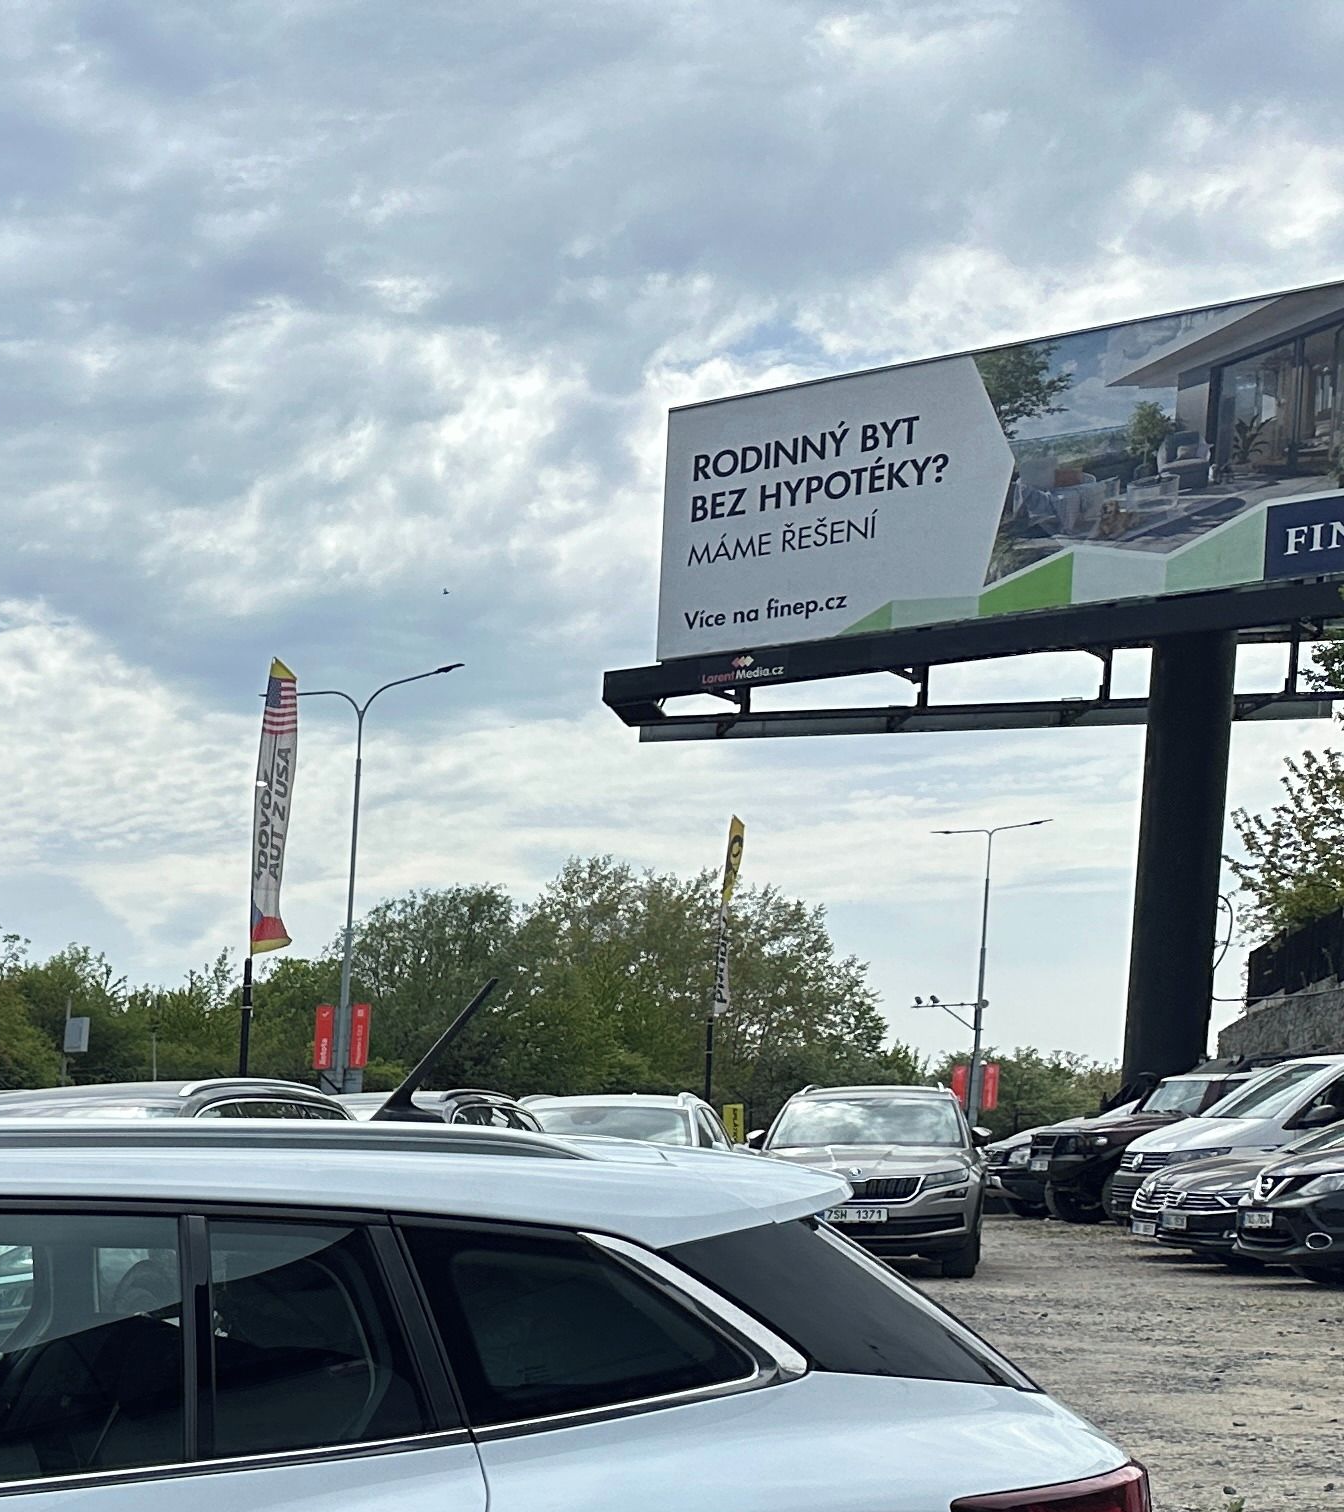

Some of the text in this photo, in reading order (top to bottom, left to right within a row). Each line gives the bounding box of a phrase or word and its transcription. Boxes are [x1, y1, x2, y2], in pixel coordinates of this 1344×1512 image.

[692, 415, 920, 482] RODINNÝ BYT
[690, 453, 950, 522] BEZ HYPOTÉKY?
[687, 508, 879, 567] MÁME ŘEŠENÍ
[684, 595, 848, 630] Více na finep.cz
[275, 746, 292, 799] USA
[268, 823, 284, 881] AUT
[855, 1209, 882, 1220] 1371
